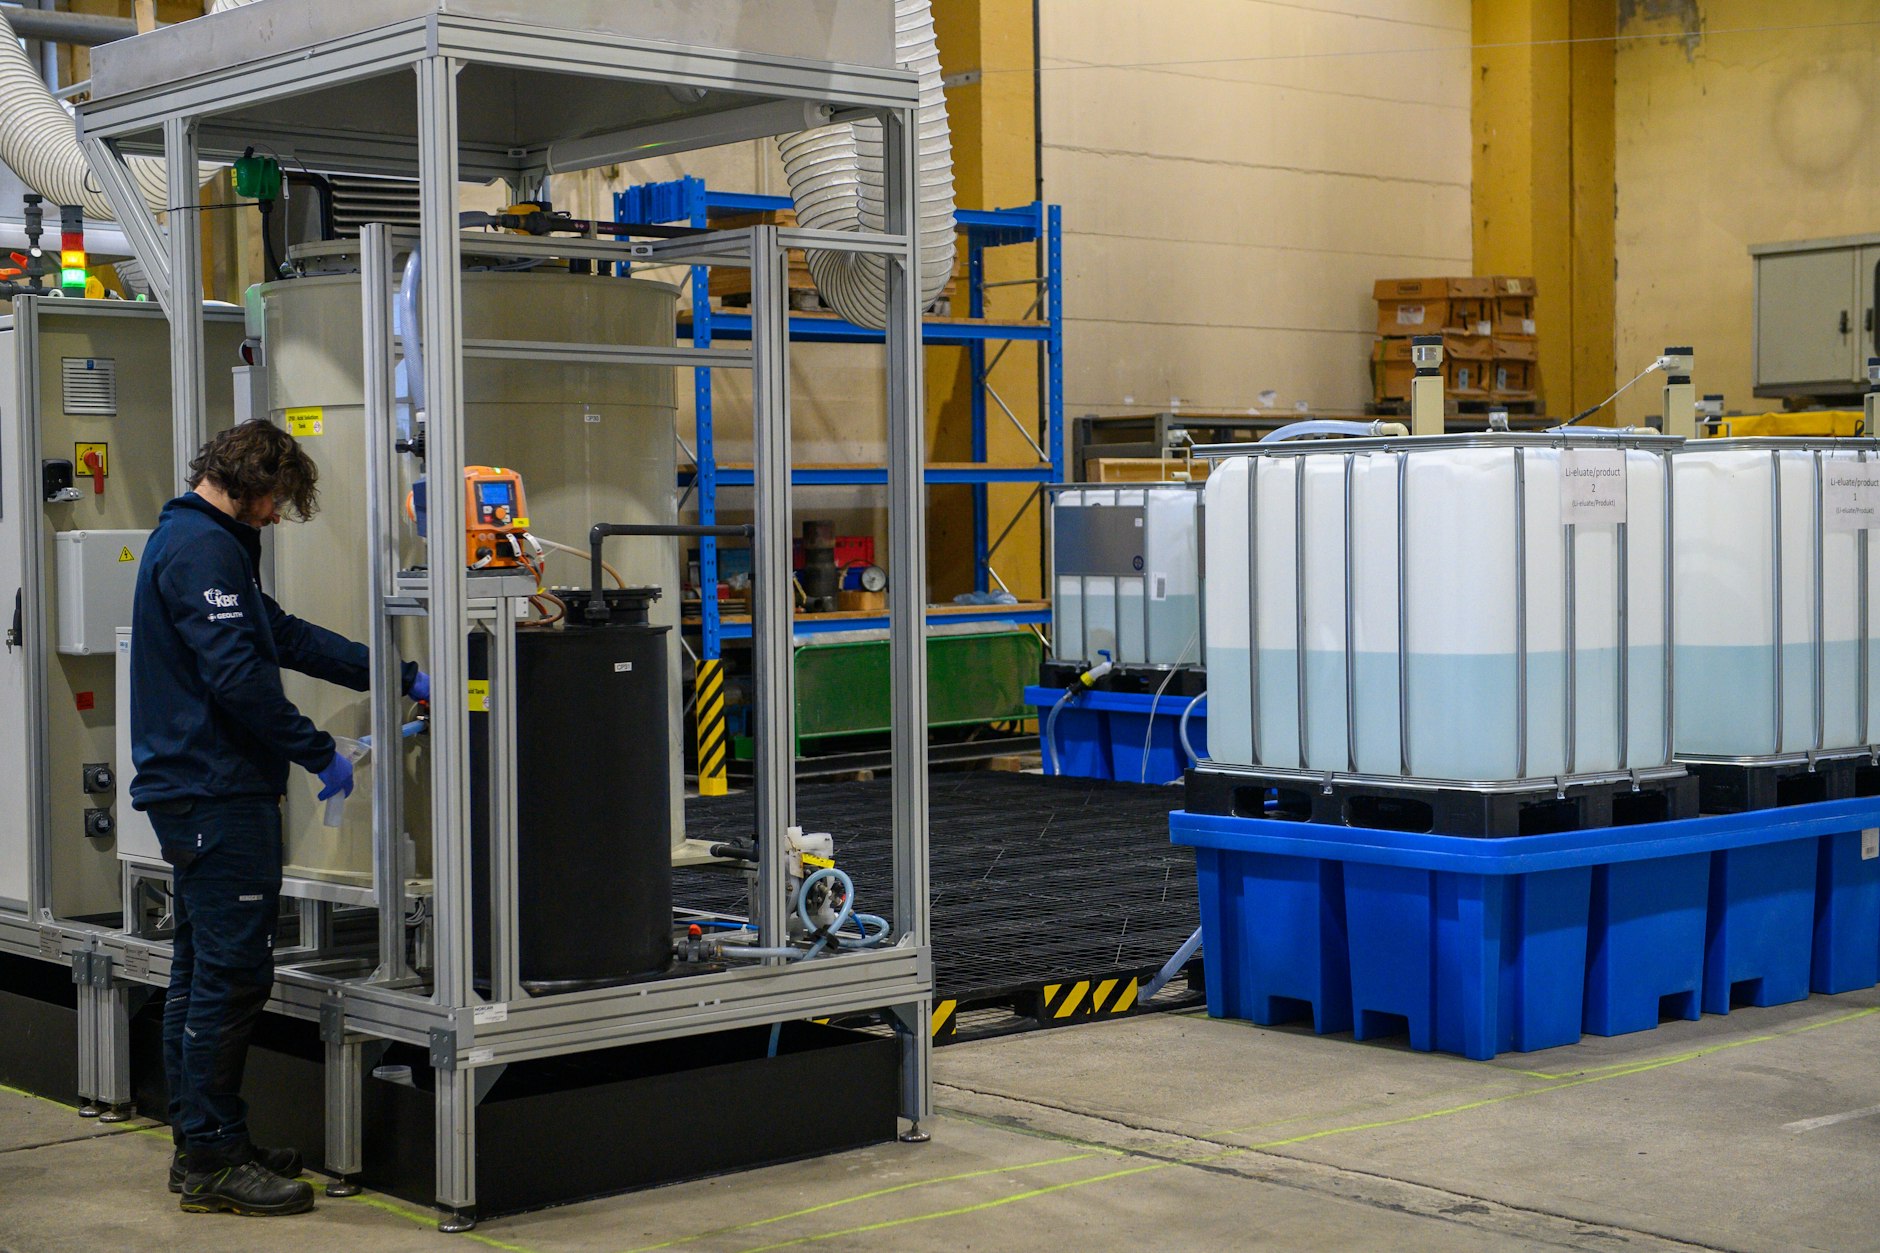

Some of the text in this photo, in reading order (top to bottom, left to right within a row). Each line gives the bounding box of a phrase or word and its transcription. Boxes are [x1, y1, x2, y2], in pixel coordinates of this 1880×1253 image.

[1565, 467, 1621, 478] Li-eluate/product
[1830, 477, 1880, 488] Li-eluate/product
[1591, 483, 1596, 493] 2
[1571, 499, 1616, 508] (Li-eluate/Produkt)
[215, 594, 239, 608] KBR
[216, 611, 244, 620] GEOLITH
